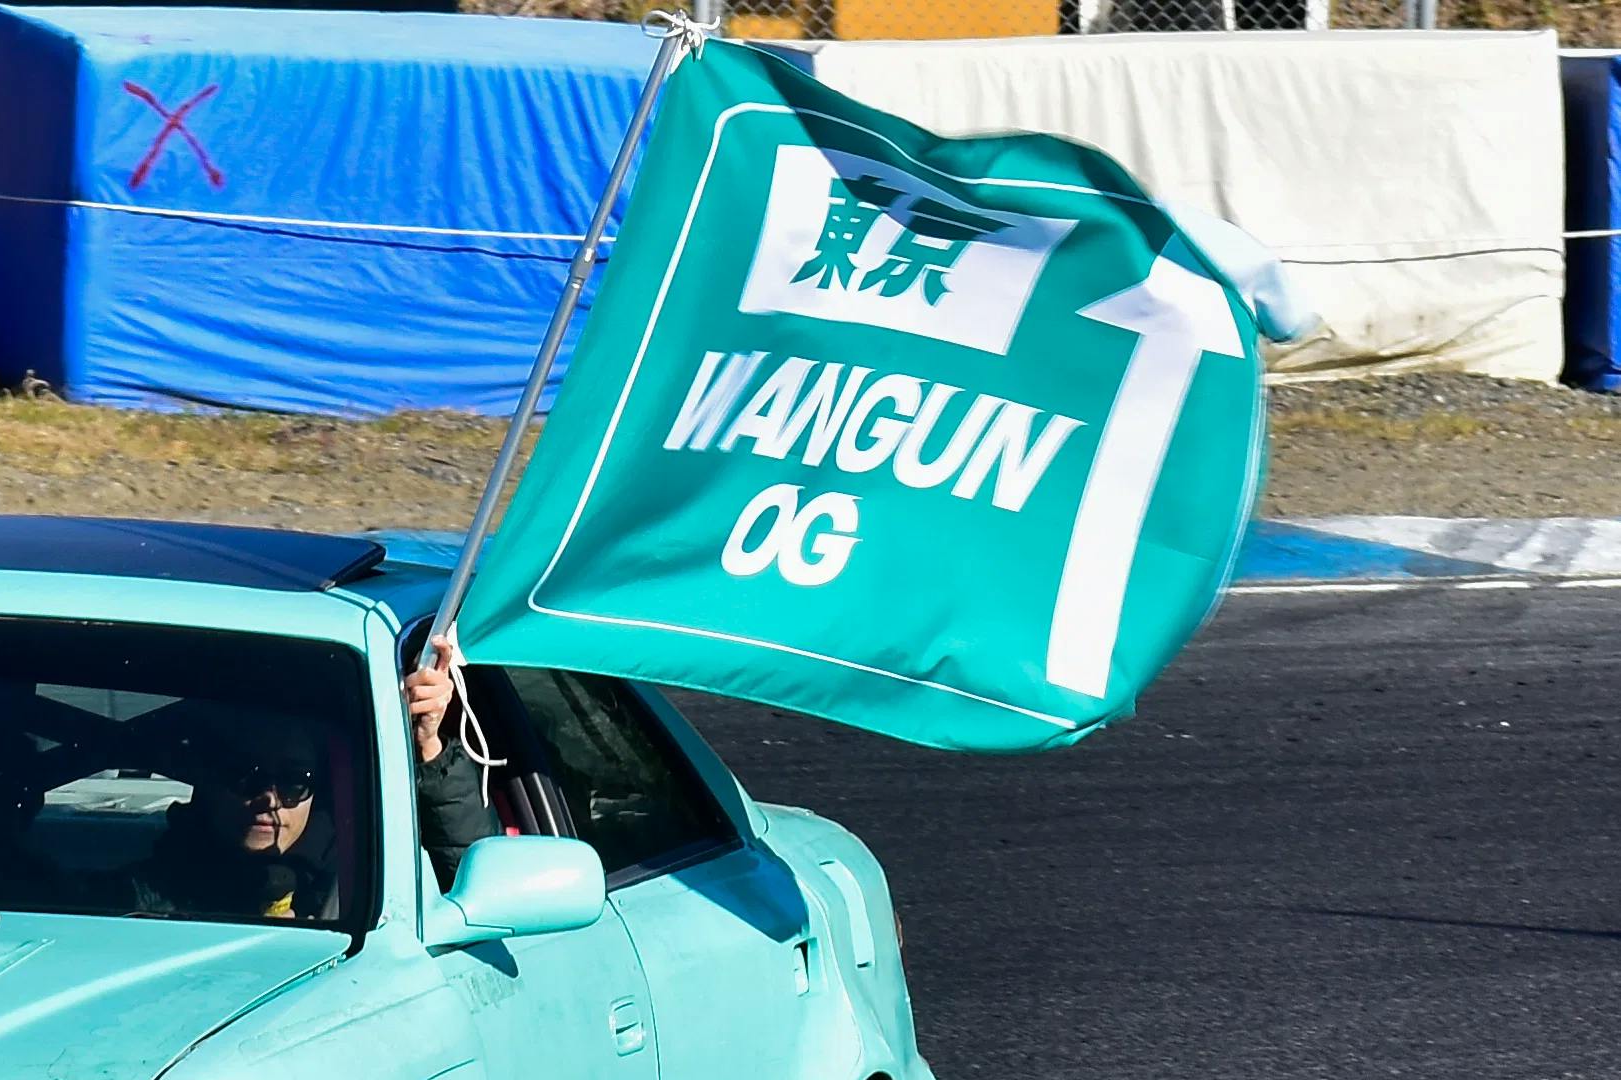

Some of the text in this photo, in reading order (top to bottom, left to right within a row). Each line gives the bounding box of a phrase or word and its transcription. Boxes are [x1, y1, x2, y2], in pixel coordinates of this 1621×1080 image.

[789, 175, 1017, 307] 東京
[663, 350, 1087, 512] WANGUN
[720, 483, 862, 586] OG
